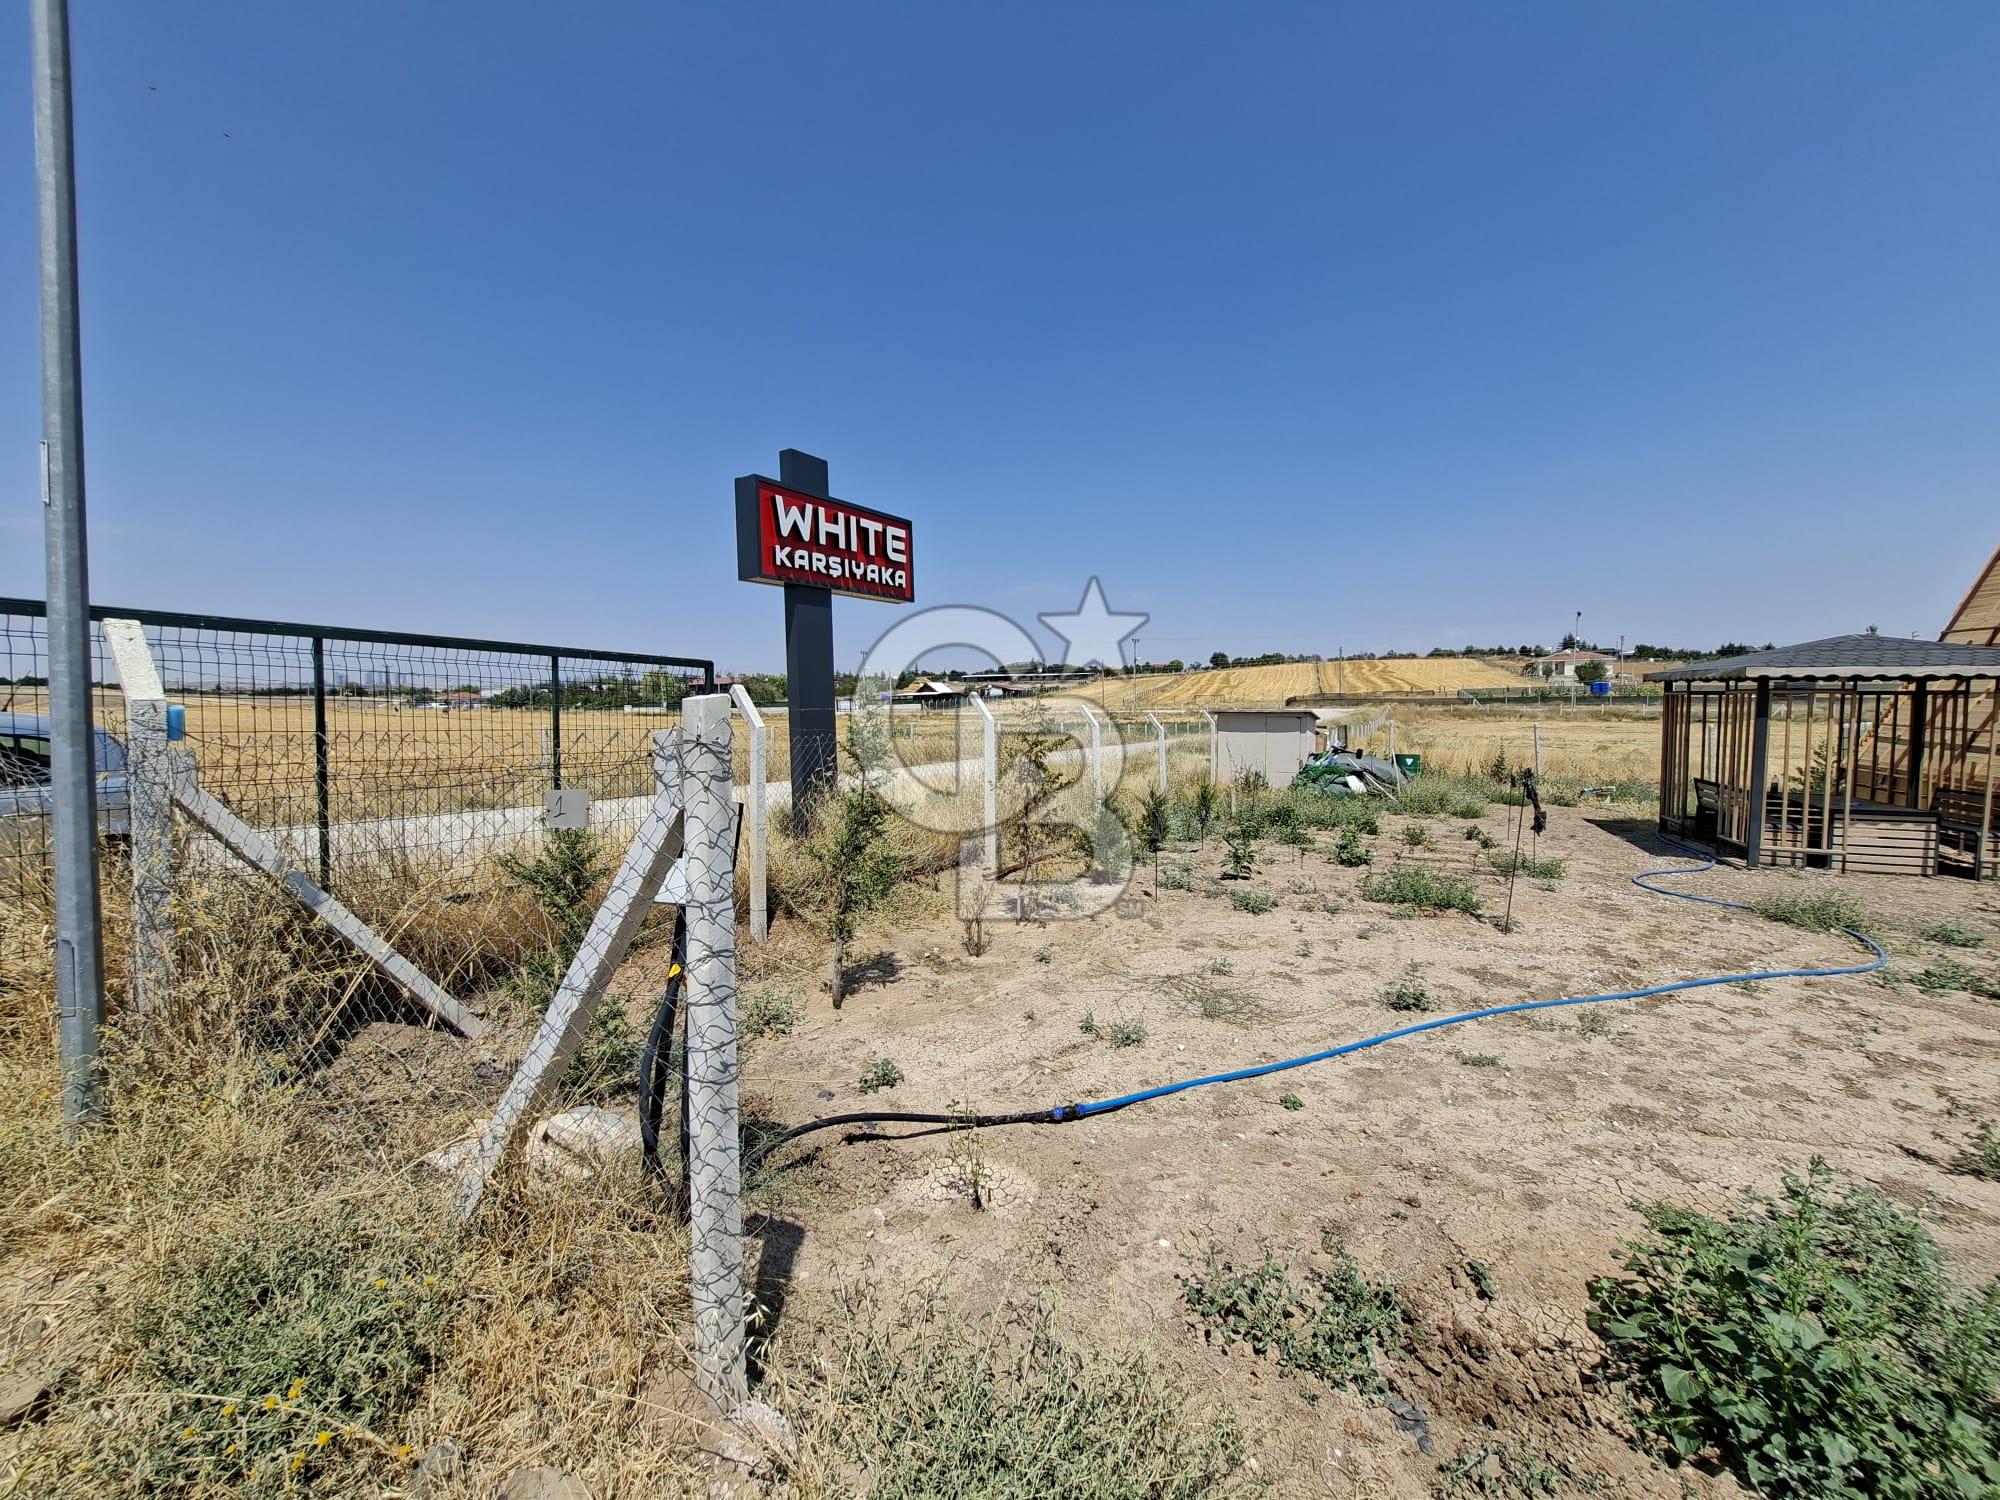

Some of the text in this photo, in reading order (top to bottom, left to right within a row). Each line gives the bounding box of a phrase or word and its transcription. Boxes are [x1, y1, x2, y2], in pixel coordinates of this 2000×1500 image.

[774, 494, 907, 564] WHITE
[774, 544, 907, 589] KARŞIYAKA
[553, 794, 567, 819] 1
